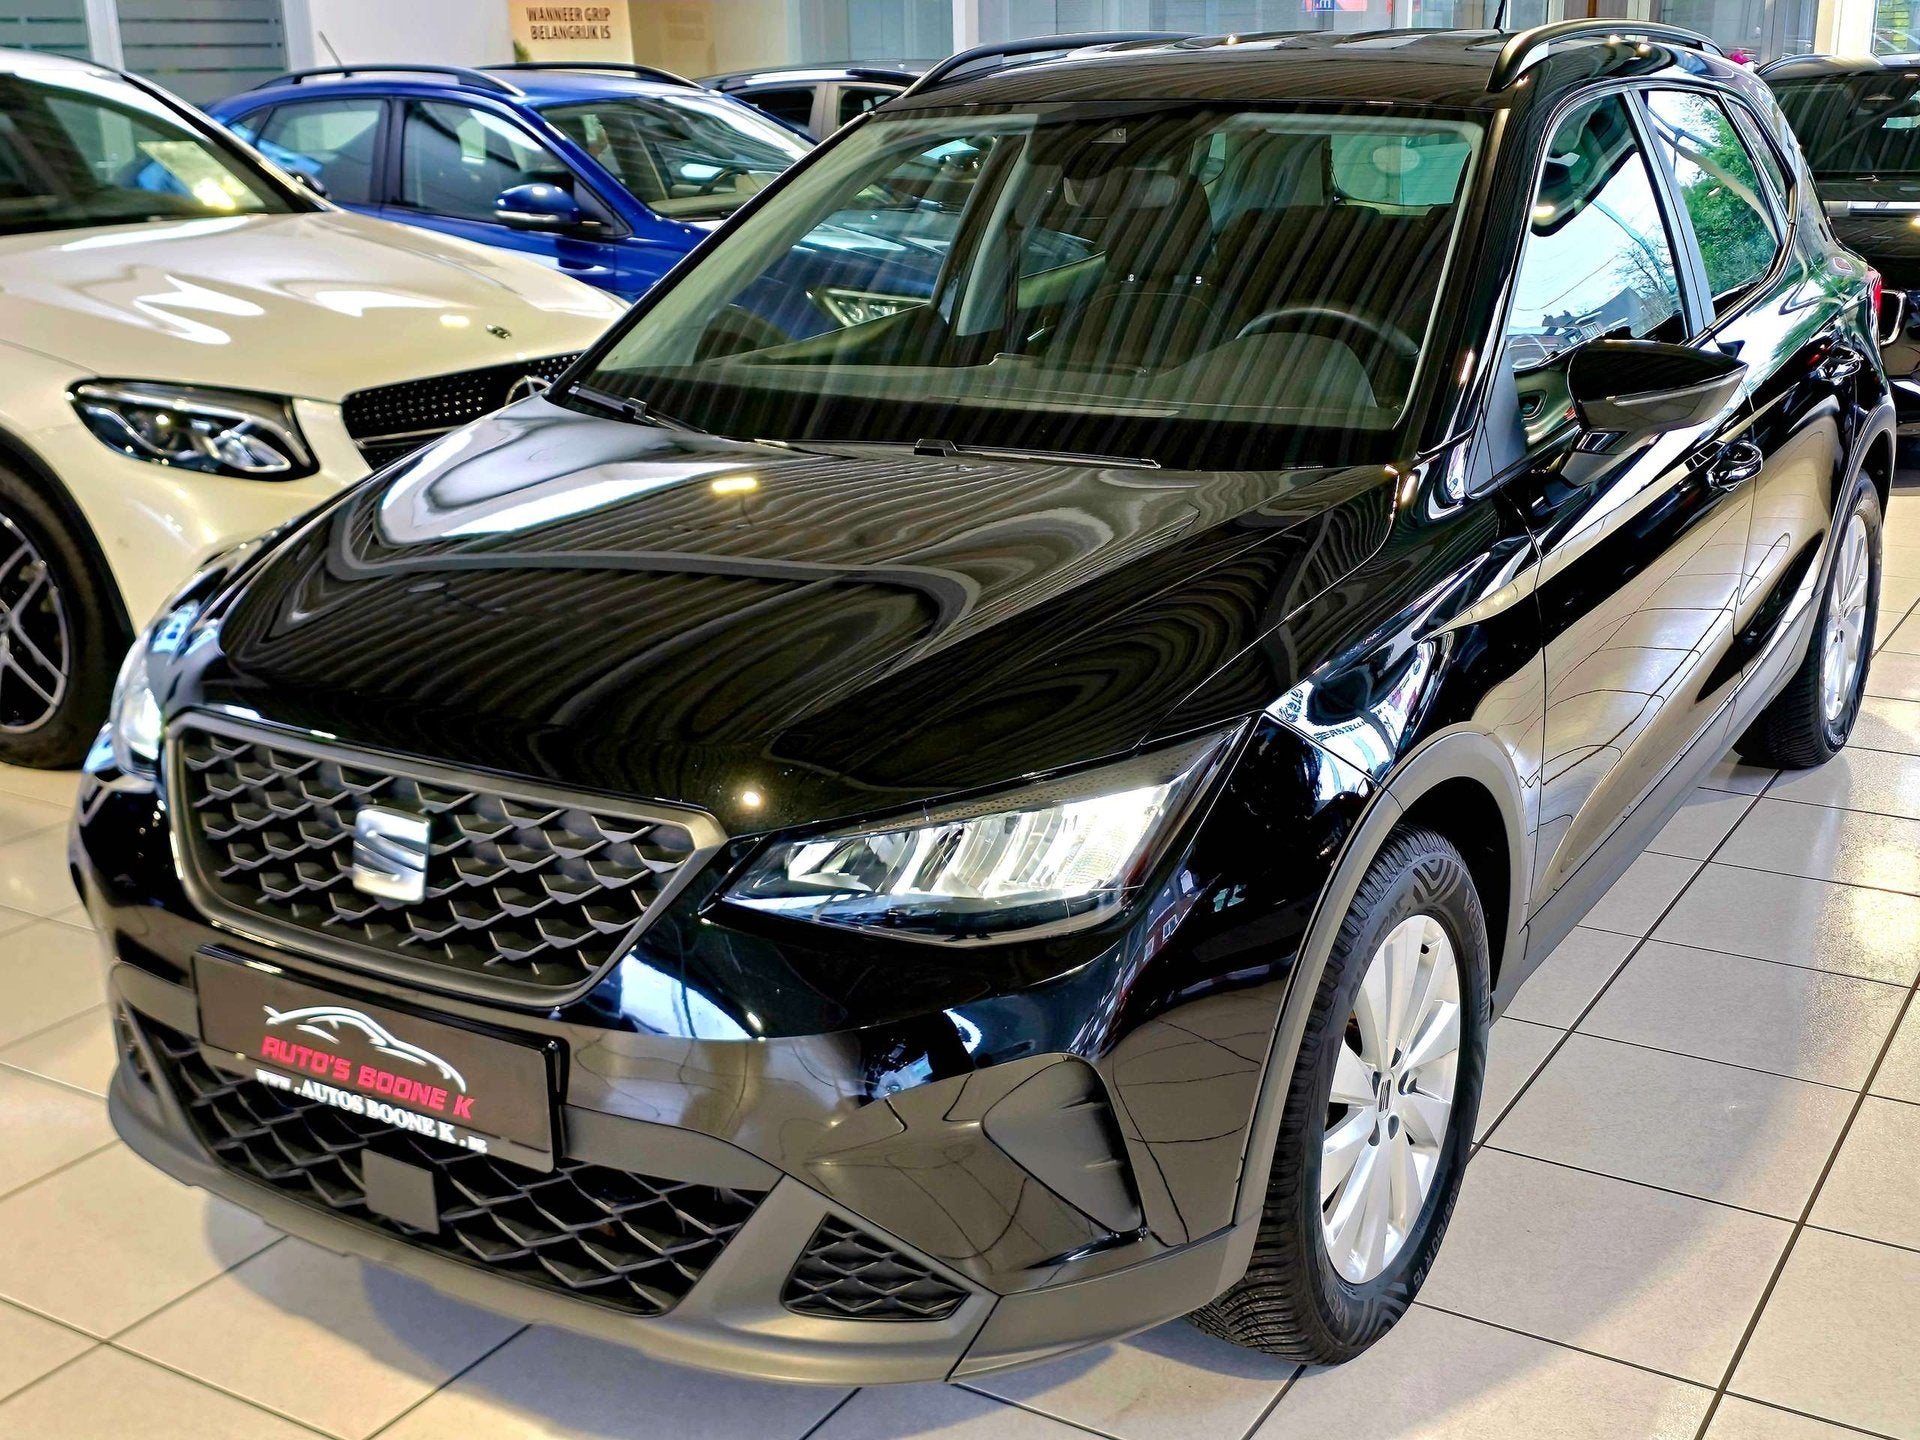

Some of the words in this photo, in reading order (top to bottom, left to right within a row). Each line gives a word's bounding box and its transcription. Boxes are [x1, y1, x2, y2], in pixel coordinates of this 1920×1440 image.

[526, 7, 583, 22] WANNEER
[584, 7, 611, 22] GRIP
[530, 25, 599, 40] BELANGRIJK
[600, 25, 611, 40] IS
[261, 1035, 352, 1082] AUTO'S
[356, 1064, 449, 1112] BOONE
[453, 1094, 476, 1120] K
